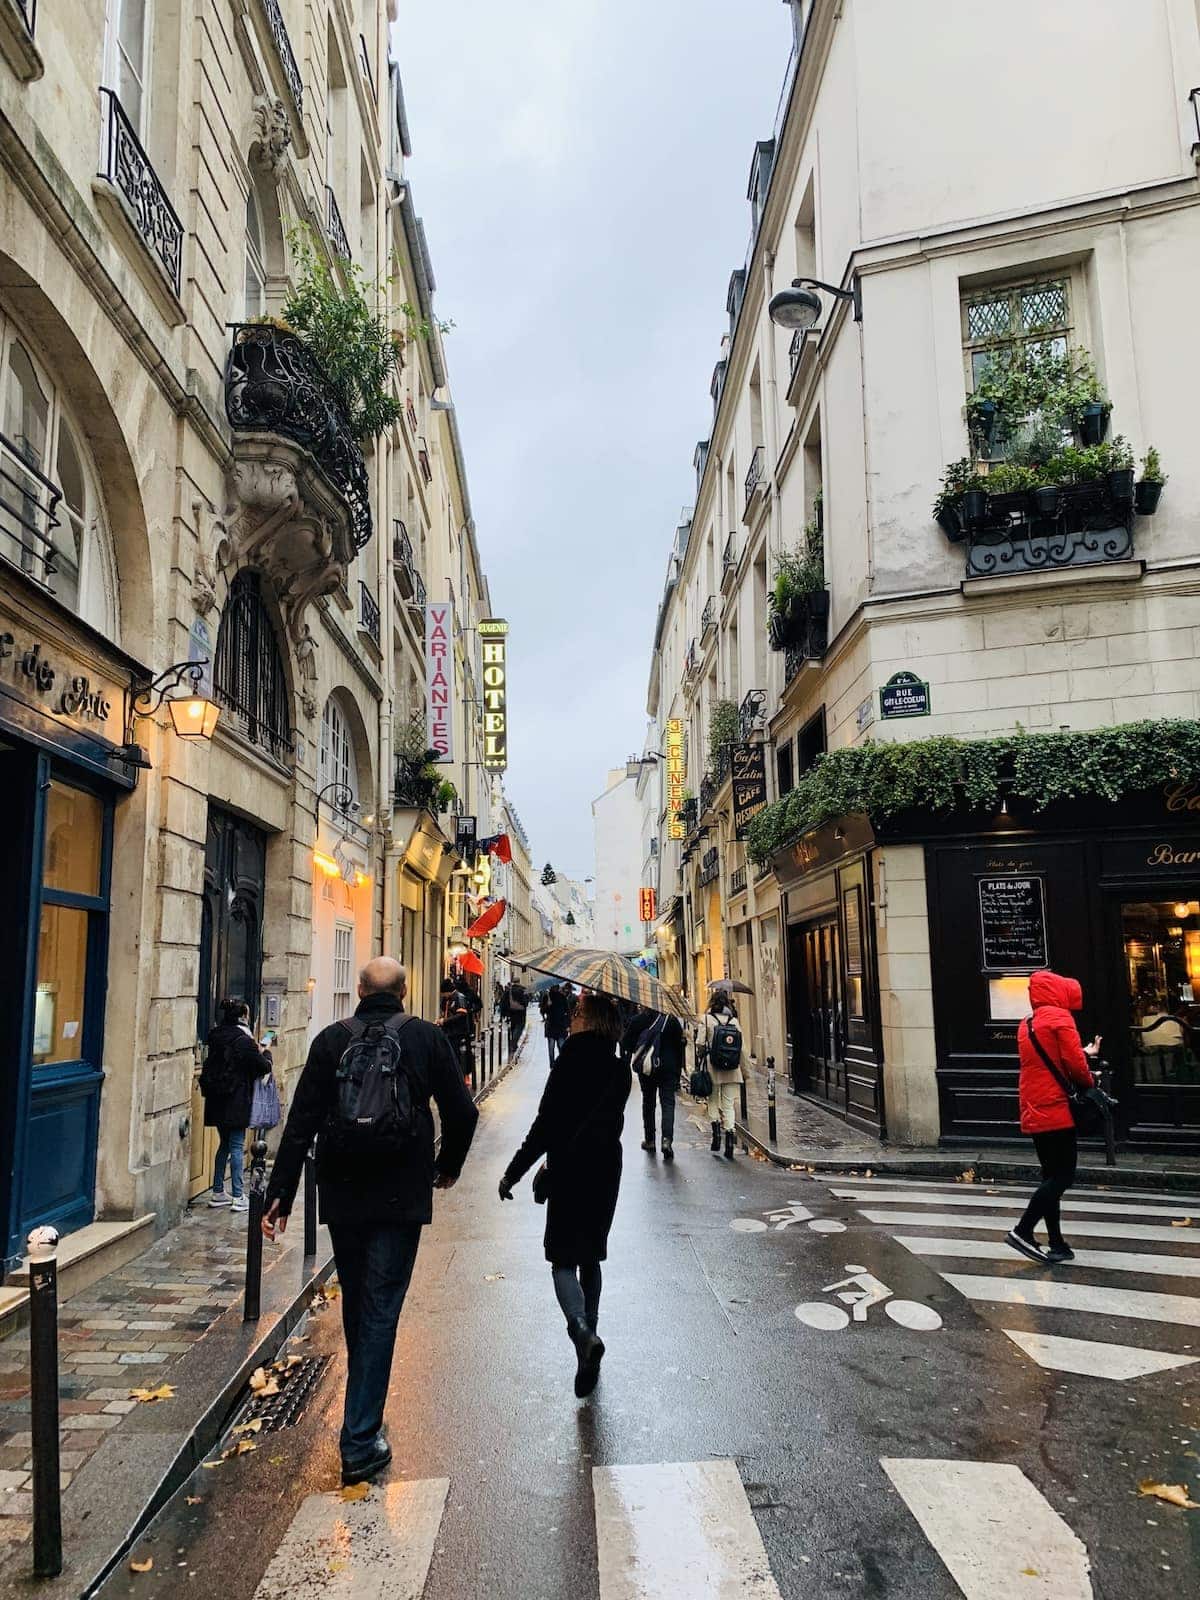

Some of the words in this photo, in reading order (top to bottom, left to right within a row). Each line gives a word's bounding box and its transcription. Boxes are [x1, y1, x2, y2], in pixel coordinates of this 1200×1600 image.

[431, 609, 449, 756] VARIANTES
[483, 643, 505, 756] HOTEL
[896, 689, 912, 697] RUE
[670, 720, 680, 732] 3
[734, 748, 761, 769] Café
[734, 767, 763, 780] Latin
